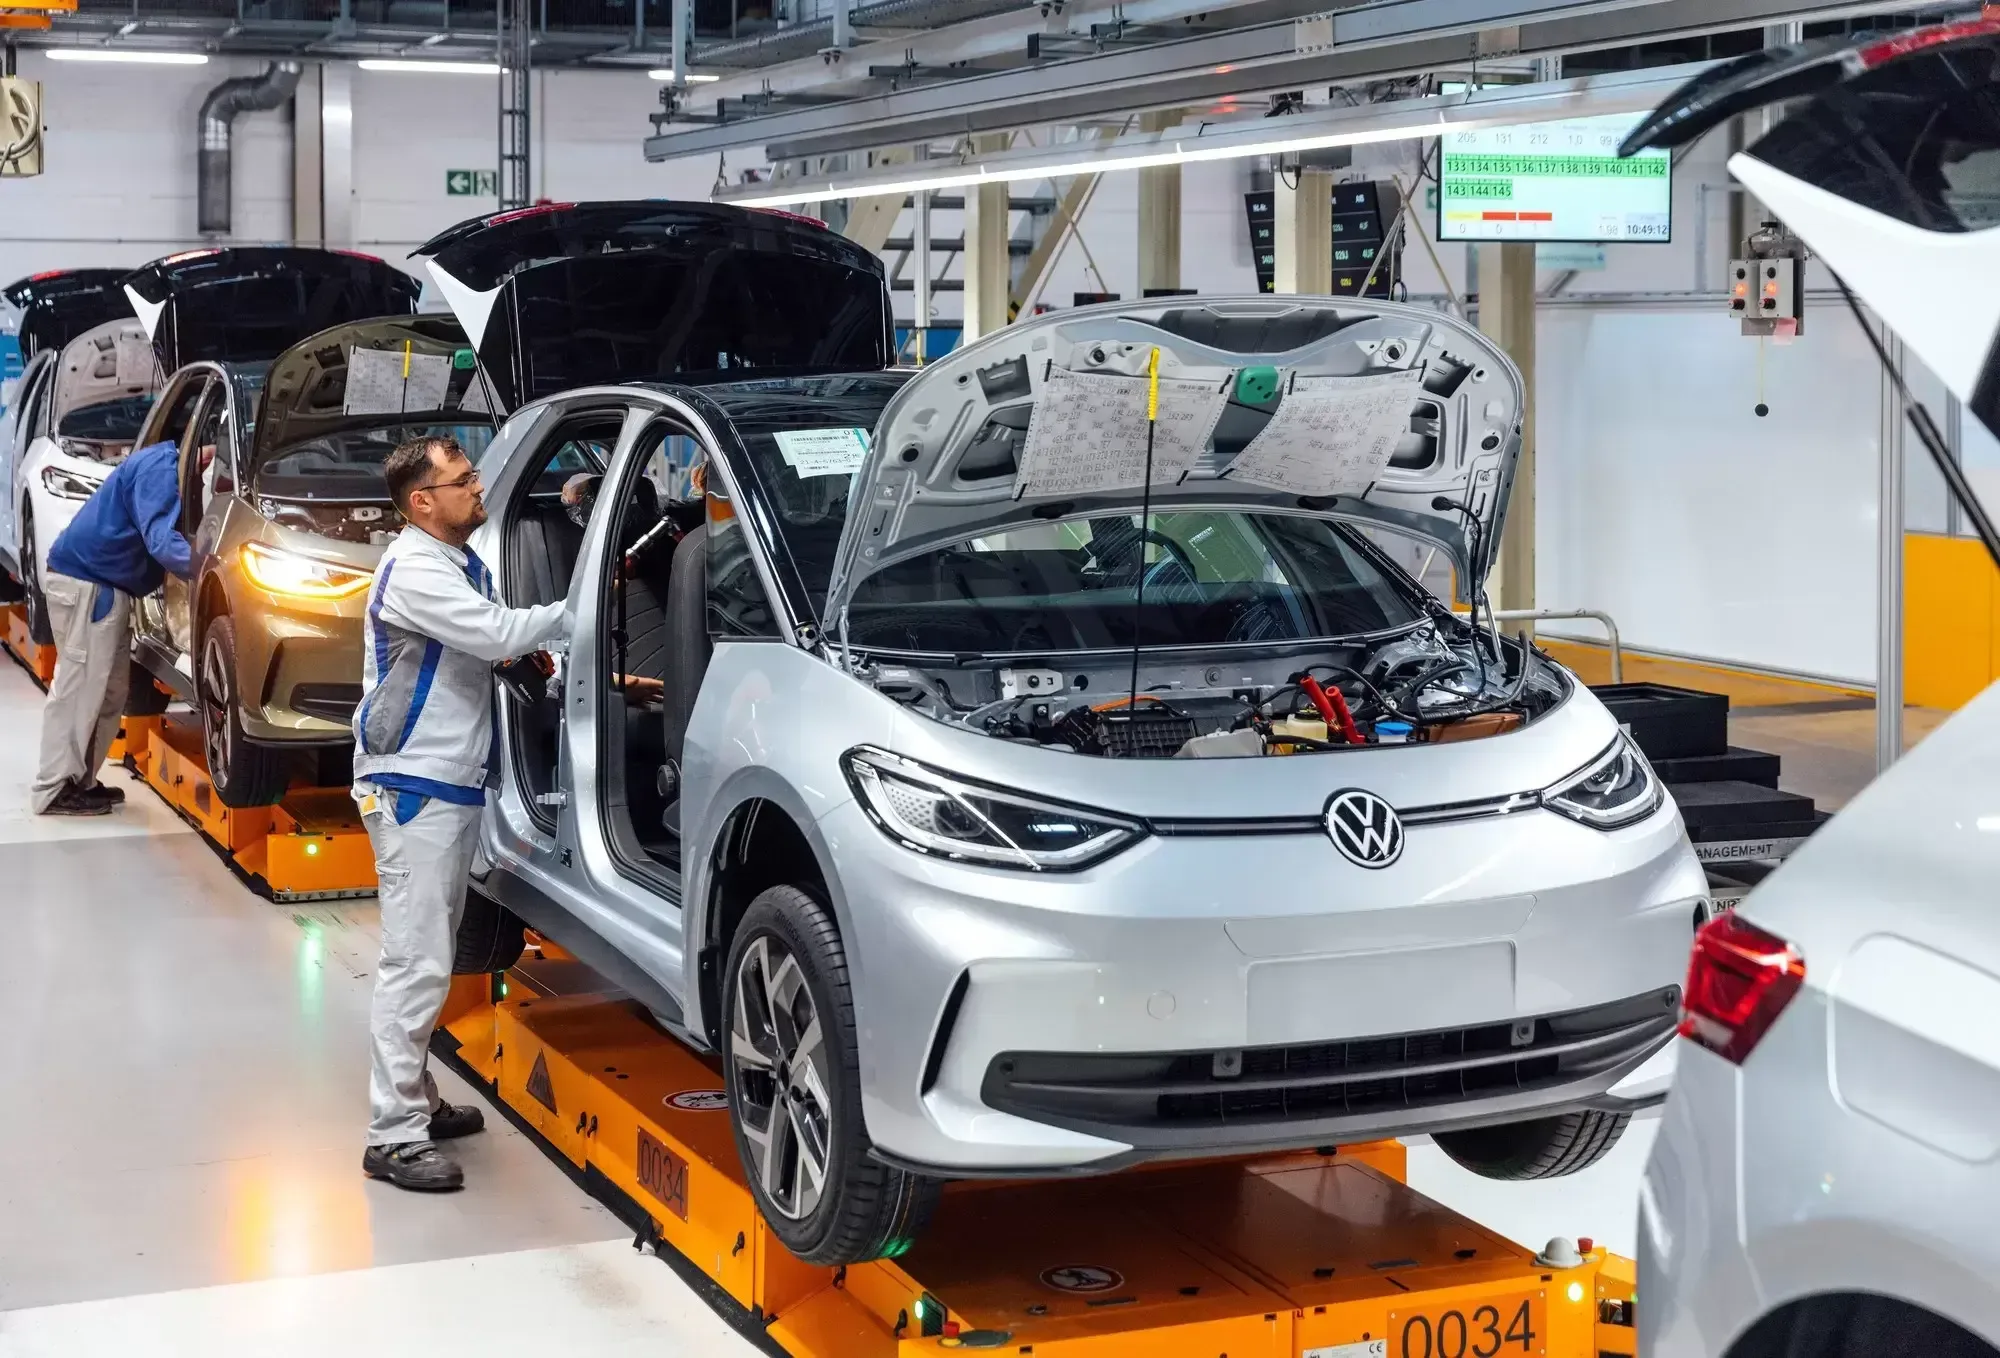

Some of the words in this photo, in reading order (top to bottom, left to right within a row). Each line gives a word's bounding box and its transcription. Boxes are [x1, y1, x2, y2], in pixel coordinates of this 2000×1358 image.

[1457, 132, 1477, 144] 205
[1495, 133, 1512, 144] 131
[1530, 134, 1548, 145] 212
[1447, 161, 1466, 172] 133
[1470, 162, 1489, 172] 134
[1493, 162, 1512, 173] 135
[1516, 163, 1534, 173] 136
[1539, 163, 1556, 173] 137
[1561, 163, 1578, 173] 138
[1583, 164, 1600, 174] 139
[1605, 164, 1622, 175] 140
[1627, 165, 1643, 175] 141
[1648, 165, 1665, 176] 142
[1447, 185, 1466, 196] 143
[1470, 186, 1489, 196] 144
[1493, 186, 1512, 197] 145
[1627, 224, 1667, 235] 10:49:12
[1697, 844, 1773, 859] ANAGEMENT
[640, 1140, 686, 1212] 0034
[1402, 1299, 1536, 1358] 0034
